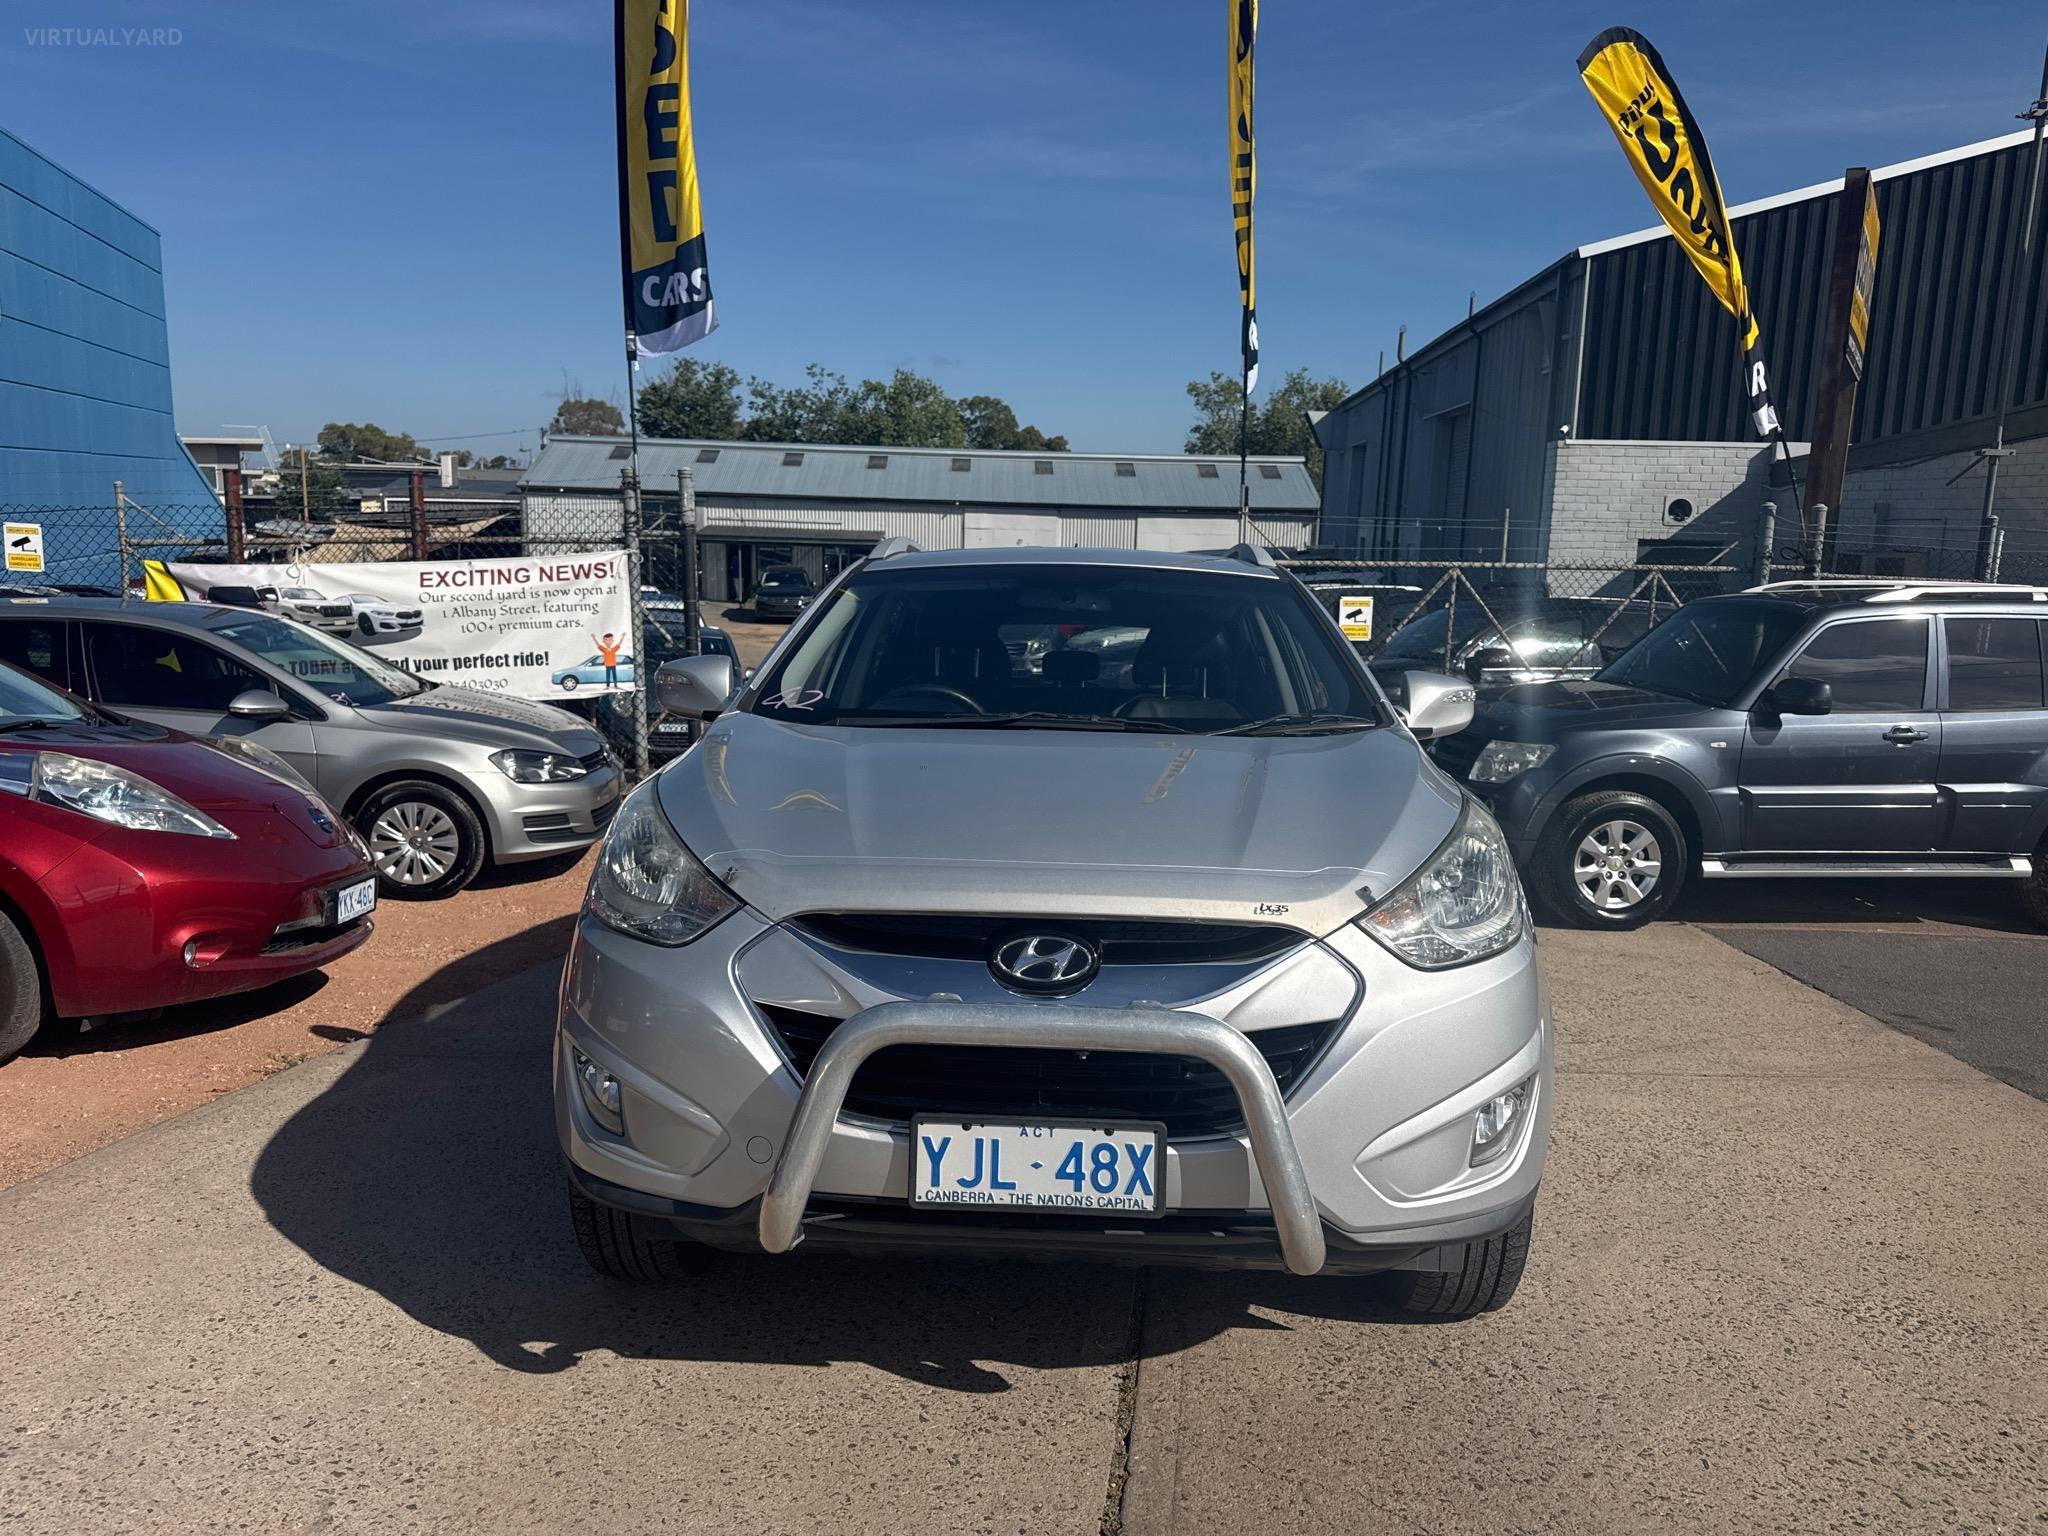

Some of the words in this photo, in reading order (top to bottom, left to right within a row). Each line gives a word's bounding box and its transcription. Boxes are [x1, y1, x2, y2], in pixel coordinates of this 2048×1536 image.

[642, 267, 707, 307] CARS
[419, 567, 531, 588] EXCITING
[539, 561, 614, 582] NEWS!
[419, 591, 446, 604] Our
[450, 588, 493, 603] second
[497, 587, 526, 605] yard
[530, 586, 540, 599] is
[544, 589, 570, 599] now
[574, 586, 604, 600] open
[607, 585, 617, 595] at
[451, 605, 496, 621] Albany
[543, 600, 599, 615] featuring
[461, 621, 493, 634] 100+
[499, 617, 553, 634] premium
[556, 617, 584, 629] cars.
[289, 660, 336, 676] TODAY
[413, 657, 449, 673] your
[453, 653, 511, 671] perfect
[513, 651, 549, 667] ride!
[1019, 1125, 1056, 1138] ACT
[925, 1189, 995, 1203] CANBERRA
[1008, 1193, 1033, 1205] THE
[1097, 1196, 1148, 1210] CAPITAL
